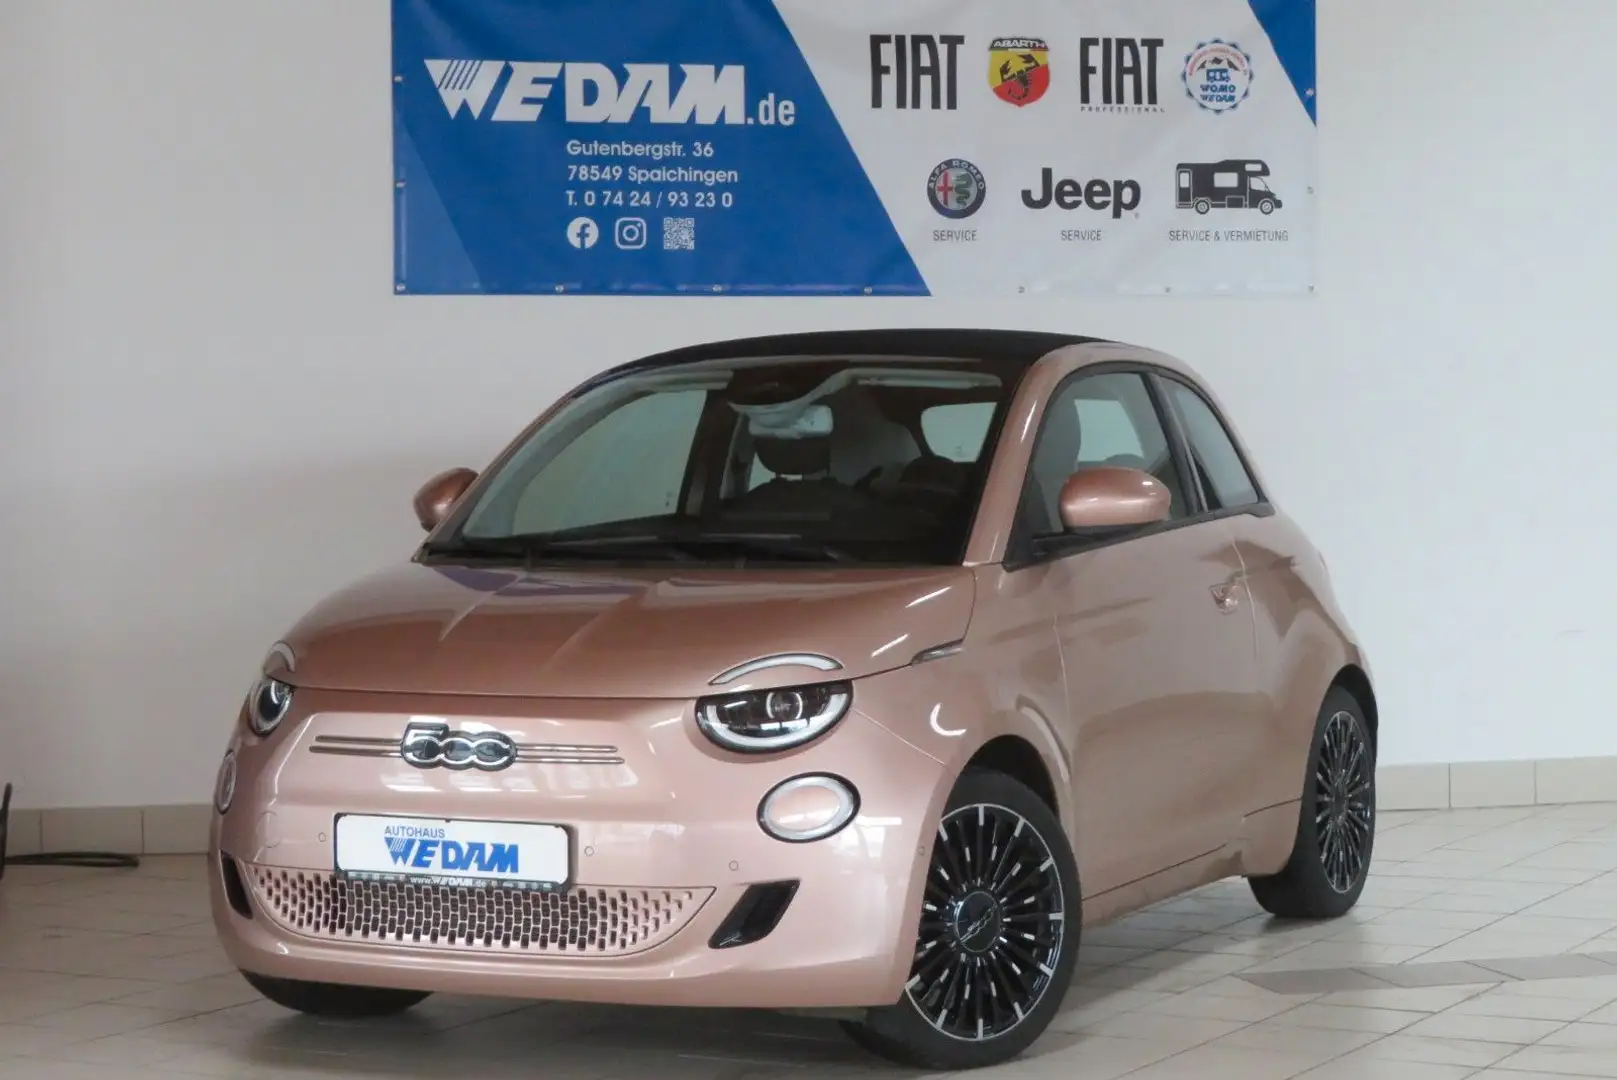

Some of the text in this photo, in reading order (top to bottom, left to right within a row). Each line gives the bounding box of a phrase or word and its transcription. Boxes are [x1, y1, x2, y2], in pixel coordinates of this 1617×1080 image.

[993, 39, 1046, 49] ABARTH
[869, 34, 965, 110] FIAT
[1079, 37, 1164, 105] FIAT
[423, 59, 796, 126] WEDAM.de
[1200, 84, 1236, 93] WOMO
[566, 139, 714, 160] Gutenbergstr. 36
[567, 165, 738, 186] 78549 Spaichingen
[929, 160, 985, 190] ALFA ROMEO
[566, 190, 733, 209] T. 0 74 24 / 93 23 0
[1021, 167, 1141, 219] Jeep
[932, 229, 977, 242] SERVICE
[1060, 229, 1102, 242] SERVICE
[1168, 229, 1289, 242] SERVICE & VERMIETUNG
[402, 722, 518, 771] 500
[384, 825, 446, 839] AUTOHAUS
[384, 836, 519, 874] WEDAM
